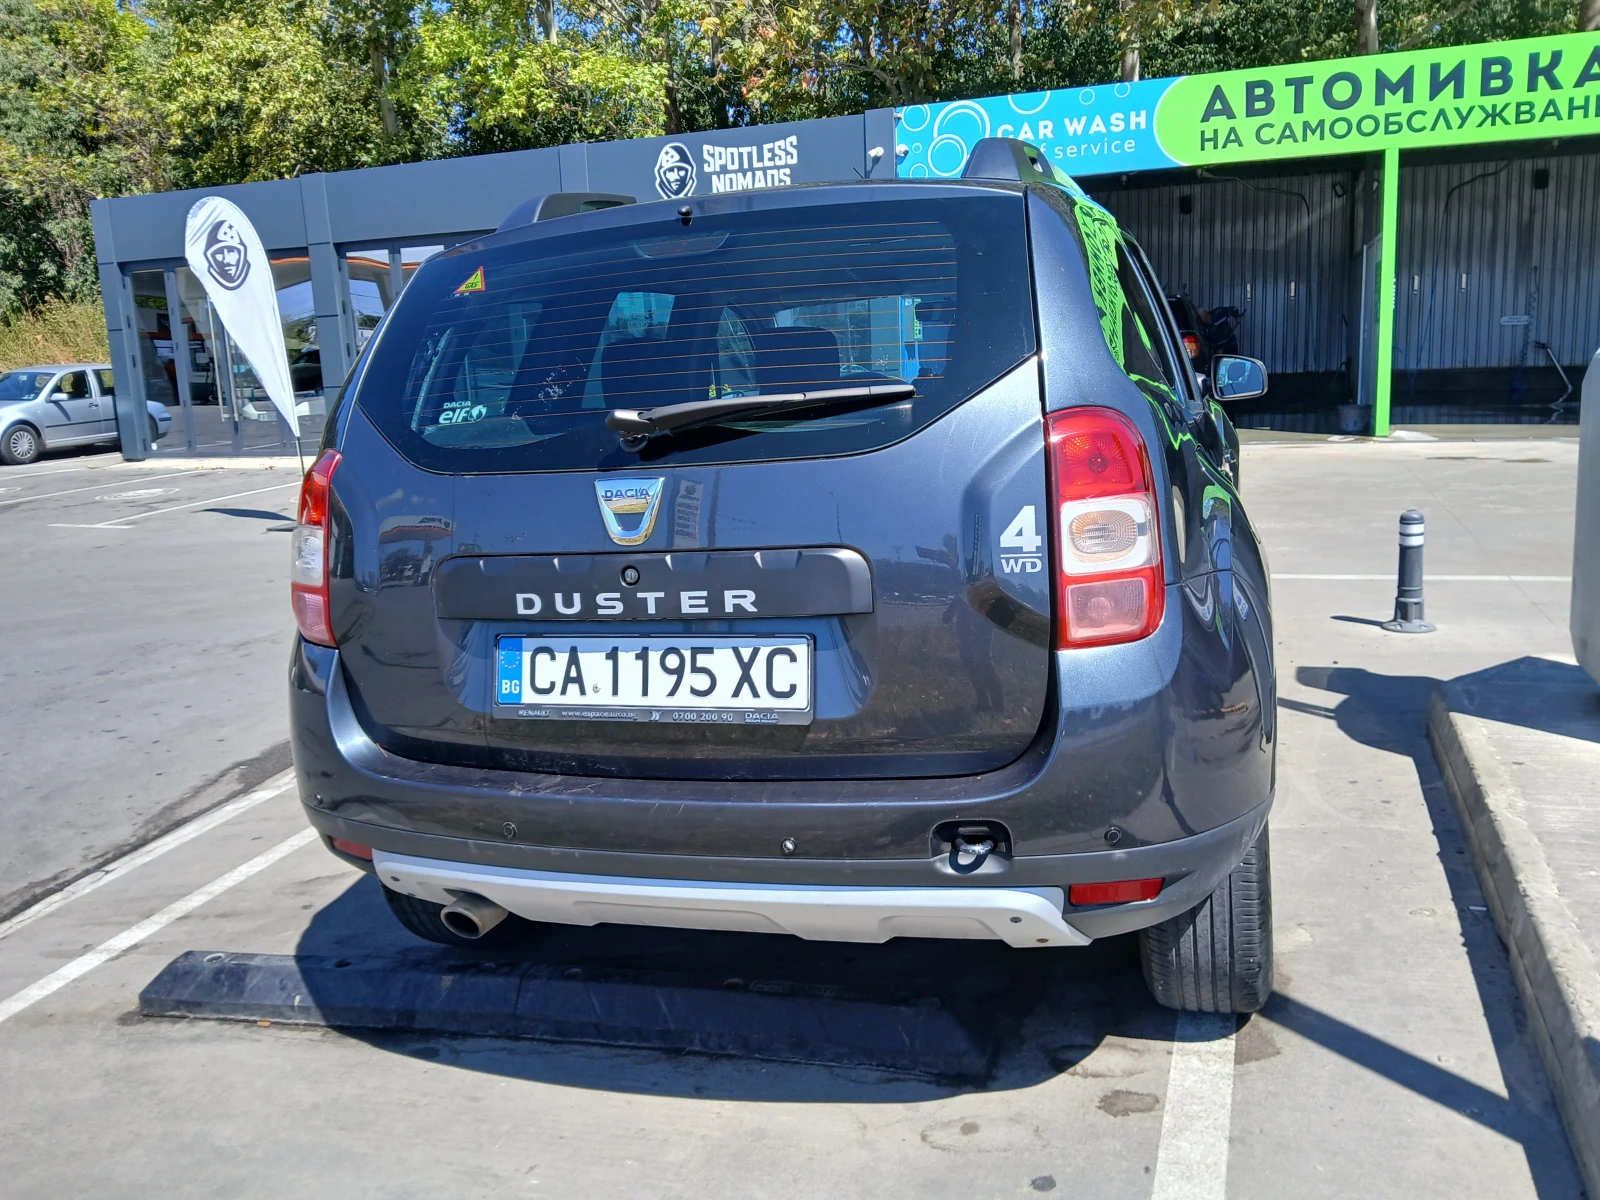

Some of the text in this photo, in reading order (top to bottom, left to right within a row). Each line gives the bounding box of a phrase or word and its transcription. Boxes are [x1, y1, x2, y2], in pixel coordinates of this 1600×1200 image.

[1200, 45, 1600, 123] АВТОМИВКА
[997, 110, 1147, 140] CAR WASH
[1200, 94, 1600, 151] НА САМООБСЛУЖВАН
[702, 135, 798, 172] SPOTLESS
[1054, 137, 1136, 159] service
[711, 168, 791, 193] NOMADS
[443, 400, 472, 409] DACIA
[438, 407, 470, 424] elf
[604, 487, 651, 499] DACIA
[1000, 505, 1042, 552] 4
[1000, 558, 1042, 573] WD
[515, 590, 758, 615] DUSTER
[501, 679, 520, 694] BG
[518, 709, 551, 717] RENAULT
[672, 712, 734, 722] 0700 200 90
[745, 712, 779, 720] DACIA
